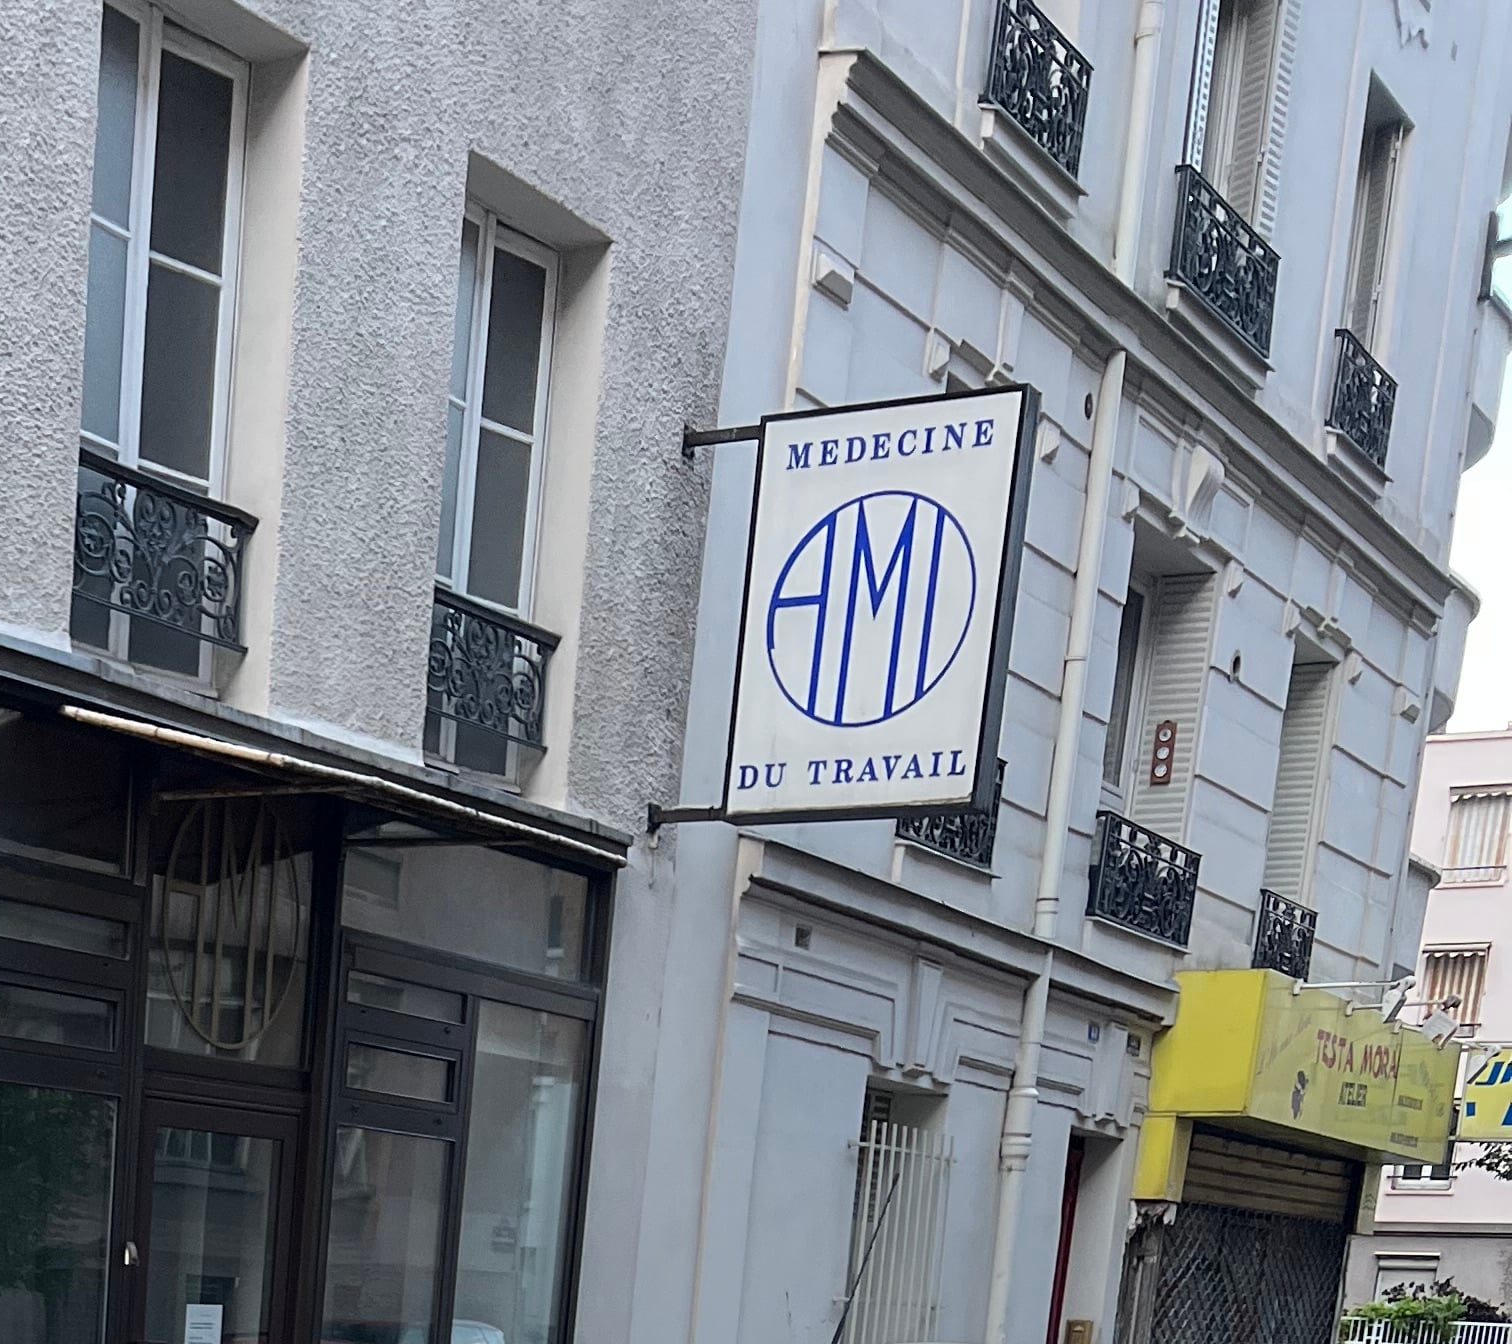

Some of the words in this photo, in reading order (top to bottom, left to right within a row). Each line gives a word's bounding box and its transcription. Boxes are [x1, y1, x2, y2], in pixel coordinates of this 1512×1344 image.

[786, 418, 996, 470] MEDECINE
[767, 494, 950, 726] AMI
[737, 762, 788, 791] DU
[807, 749, 967, 786] TRAVAIL
